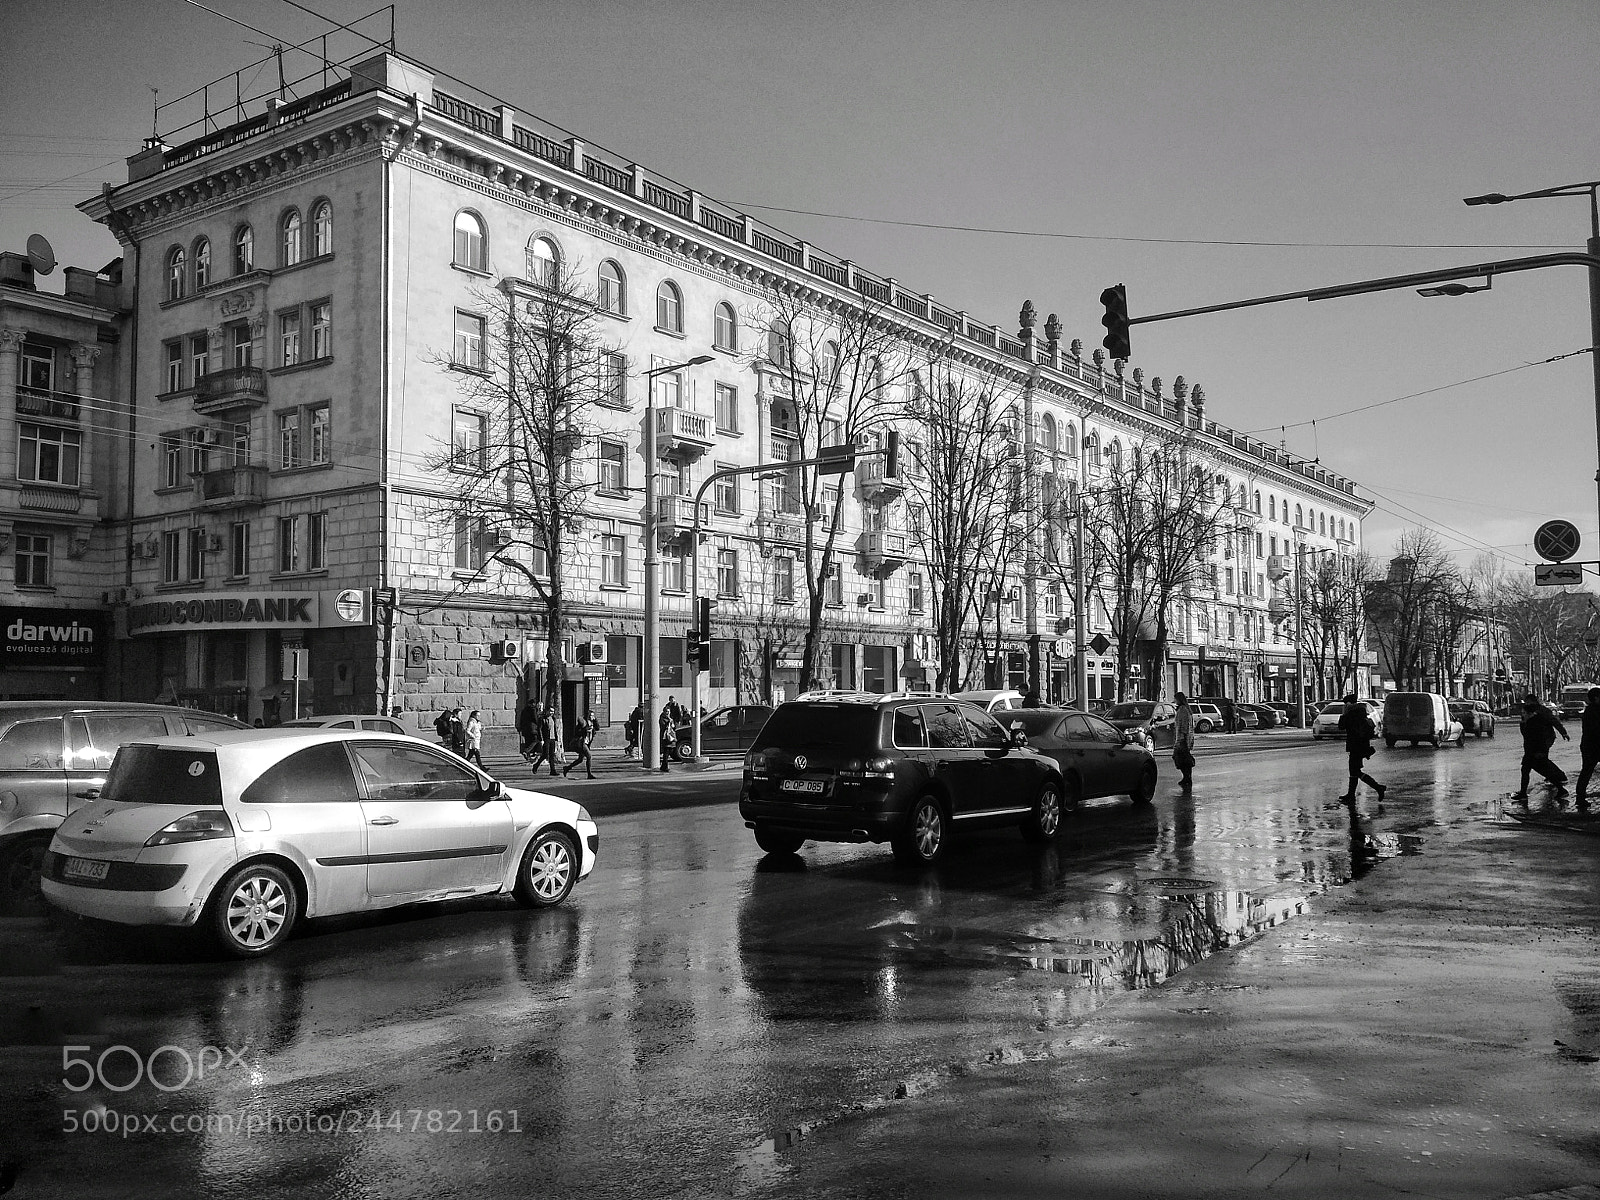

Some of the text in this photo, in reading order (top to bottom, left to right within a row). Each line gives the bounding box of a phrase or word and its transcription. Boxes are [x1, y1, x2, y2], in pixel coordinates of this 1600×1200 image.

[7, 618, 93, 643] darwin
[61, 645, 93, 655] digital
[807, 782, 822, 791] 085
